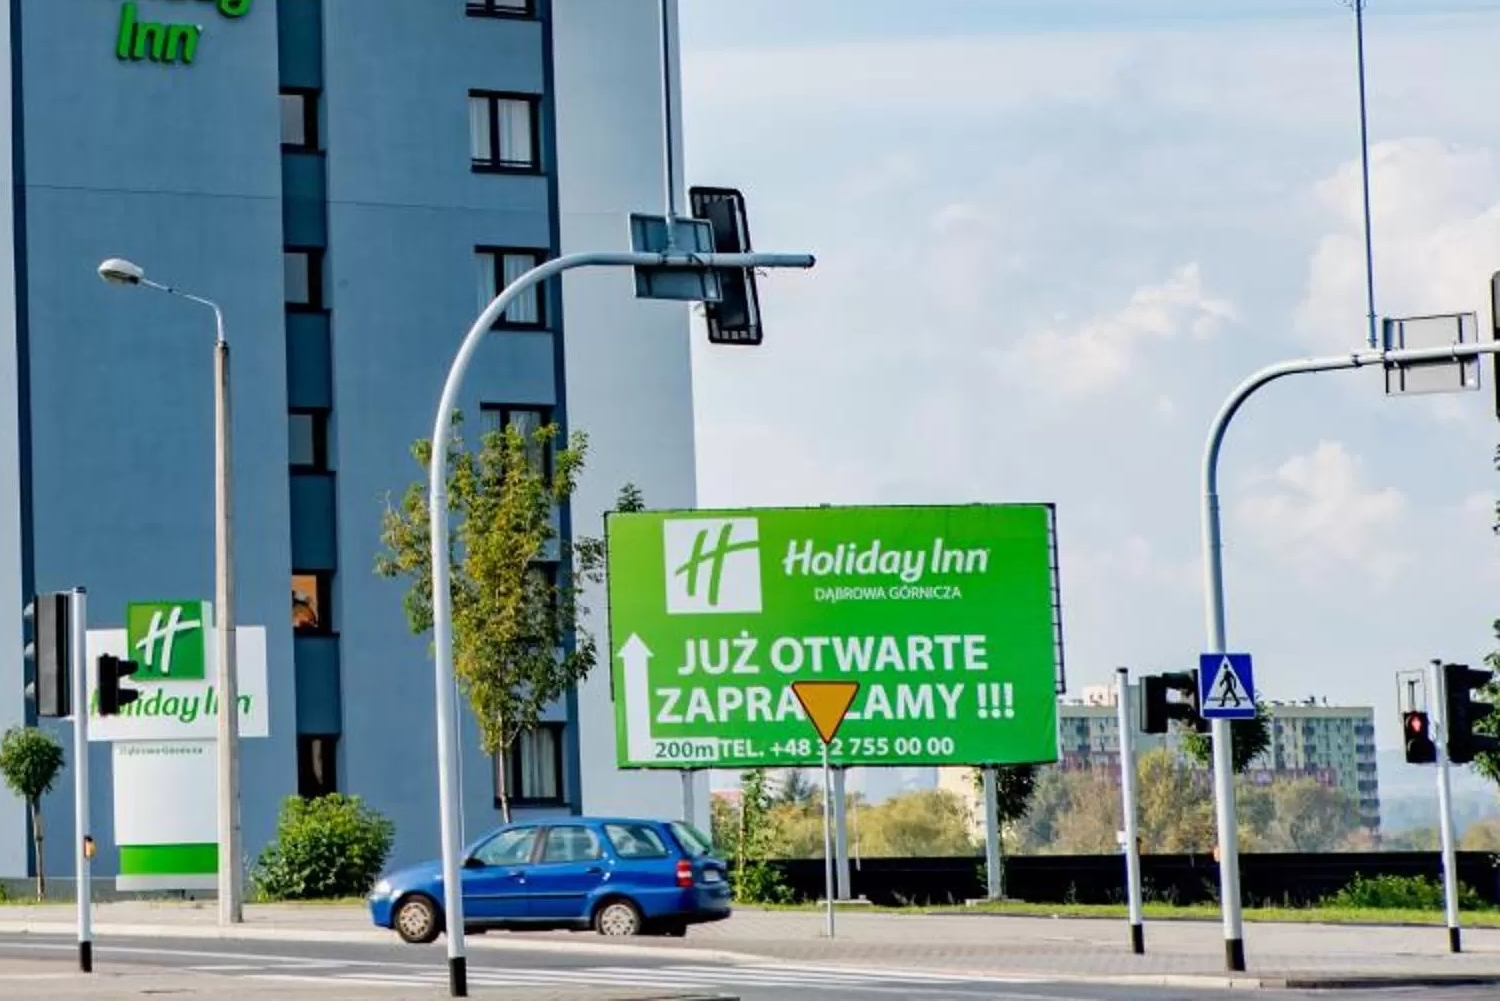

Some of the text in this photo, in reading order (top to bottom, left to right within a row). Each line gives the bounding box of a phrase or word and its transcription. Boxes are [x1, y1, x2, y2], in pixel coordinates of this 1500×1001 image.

[115, 0, 198, 64] Inn
[782, 537, 988, 582] Holiday Inn
[814, 584, 962, 603] DĄBROWA GÓRNICZA
[677, 629, 989, 675] JUŻ OTWARTE
[656, 683, 1015, 724] ZAPRAAMY !!!
[655, 741, 714, 758] 200m
[718, 739, 765, 758] TEL.
[770, 738, 812, 757] +48
[849, 737, 889, 756] 755
[894, 737, 923, 756] 00
[927, 736, 955, 755] 00
